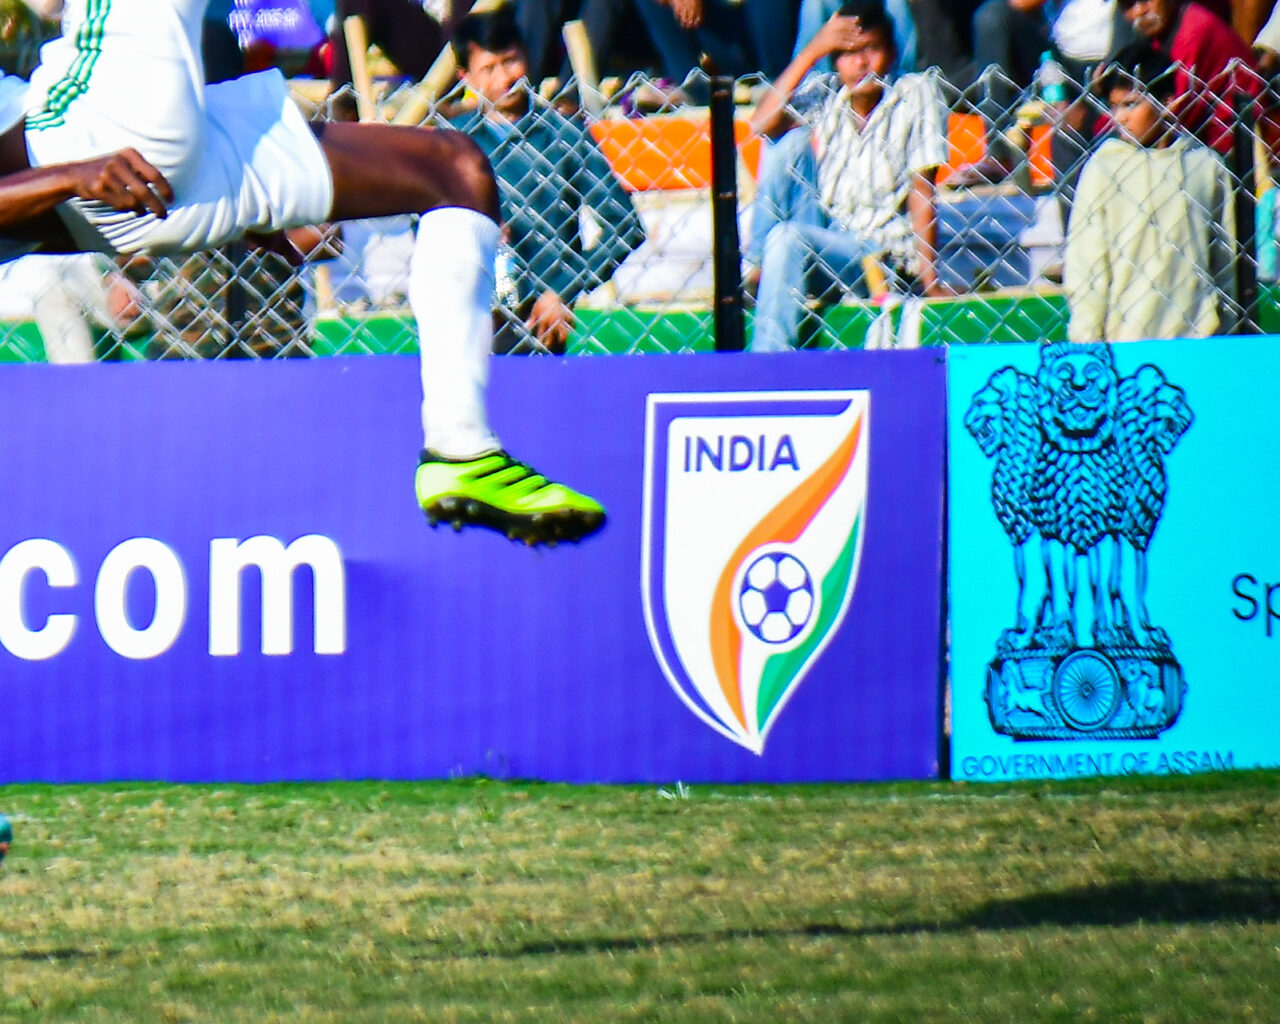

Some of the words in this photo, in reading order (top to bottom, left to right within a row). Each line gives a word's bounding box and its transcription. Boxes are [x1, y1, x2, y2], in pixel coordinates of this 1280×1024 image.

[683, 434, 800, 472] INDIA
[961, 752, 1114, 777] GOVERNMENT
[1120, 751, 1149, 775] OF
[1156, 750, 1235, 775] ASSAM
